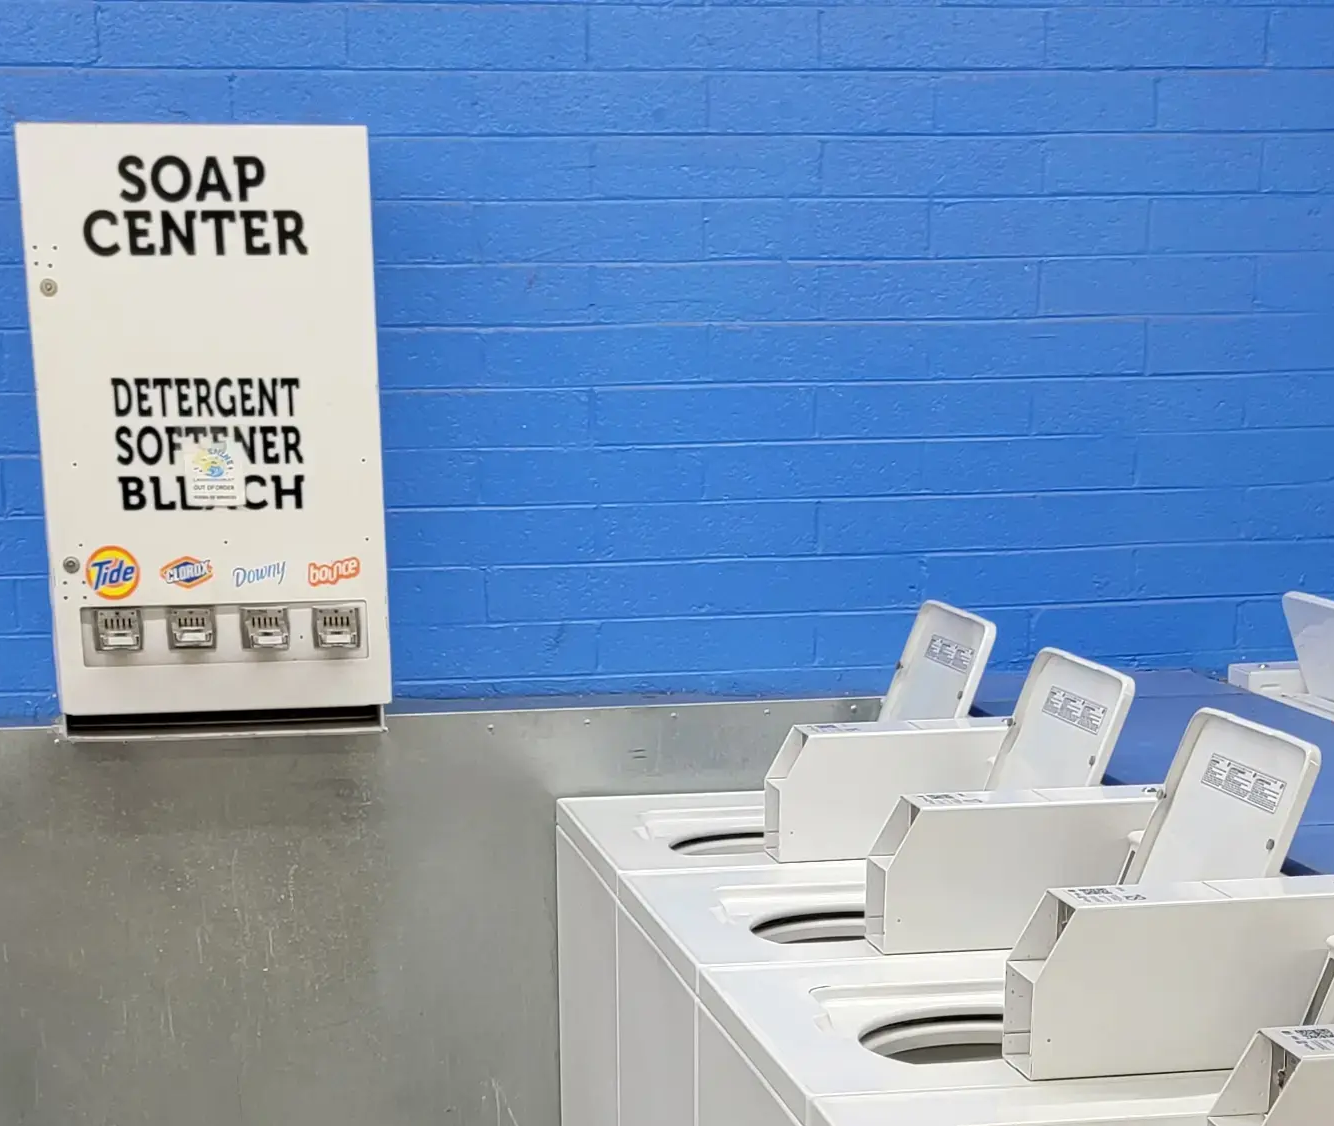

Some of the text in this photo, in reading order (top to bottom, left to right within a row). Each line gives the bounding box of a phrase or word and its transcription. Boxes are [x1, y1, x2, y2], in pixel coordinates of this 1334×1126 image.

[118, 155, 266, 203] SOAP
[83, 209, 308, 257] CENTER
[111, 377, 300, 418] DETERGENT
[118, 474, 305, 511] BLCH
[91, 560, 135, 591] Tide
[165, 558, 212, 585] CLOROX
[233, 561, 287, 588] Downy
[308, 557, 360, 587] bounce
